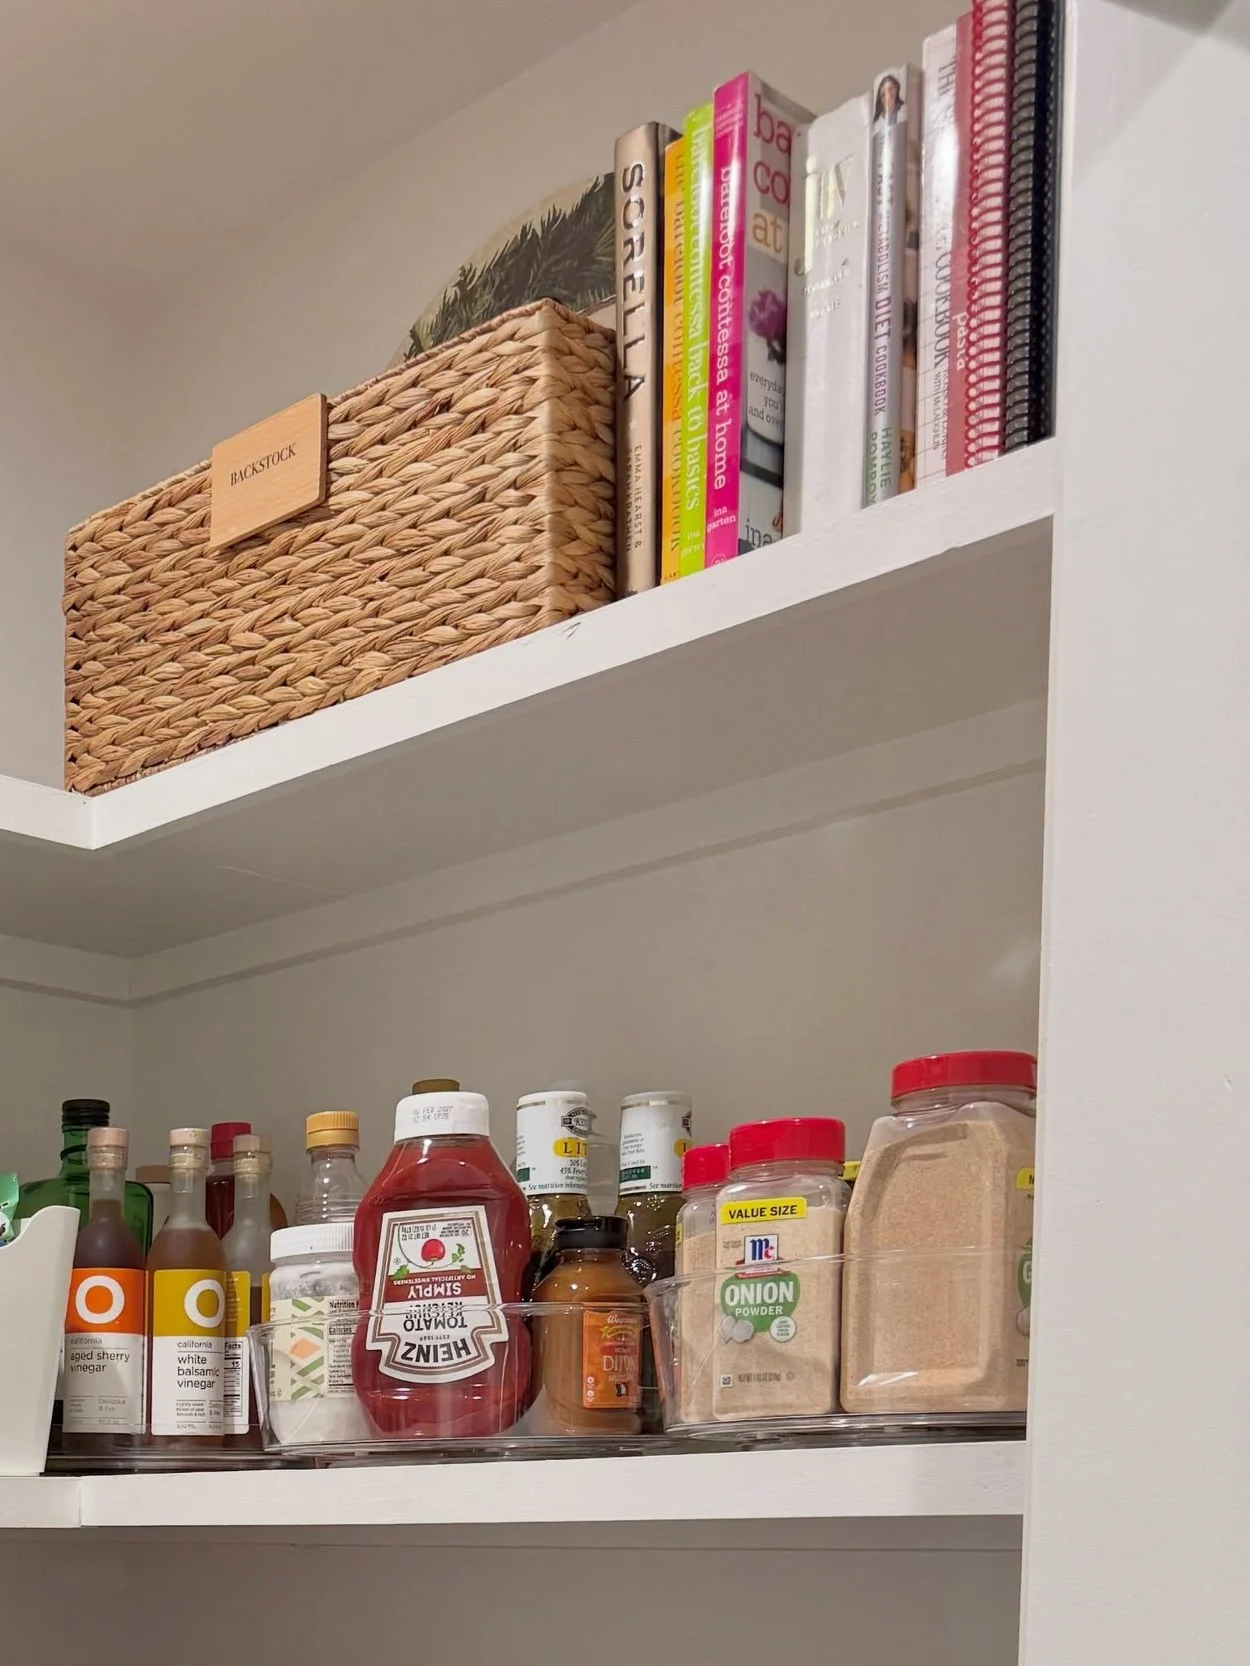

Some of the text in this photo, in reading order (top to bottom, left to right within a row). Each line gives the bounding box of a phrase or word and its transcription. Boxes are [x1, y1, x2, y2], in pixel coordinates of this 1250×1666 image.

[752, 212, 784, 253] at
[622, 163, 646, 400] SORELLA
[716, 274, 734, 384] contessa
[874, 296, 892, 340] DIET
[687, 343, 710, 397] back
[873, 345, 890, 416] COOKBOOK
[716, 389, 733, 416] at
[687, 406, 705, 431] to
[230, 443, 297, 487] BACKSTOCK
[713, 418, 732, 490] home
[879, 426, 893, 489] HAYLIE
[686, 434, 707, 511] basics
[706, 513, 737, 533] garten
[728, 1204, 798, 1219] VALUE SIZE
[393, 1276, 431, 1286] SWEETENERS
[407, 1281, 462, 1298] SIMPLY
[431, 1274, 466, 1283] ARTIFICIAL
[724, 1281, 794, 1307] ONION
[735, 1305, 783, 1317] POWDER
[403, 1316, 468, 1332] TOMATO
[70, 1336, 103, 1345] california
[177, 1340, 213, 1349] california
[400, 1338, 472, 1363] HEINZ
[70, 1350, 131, 1363] aged sherry
[177, 1355, 207, 1365] white
[70, 1363, 107, 1374] vinegar
[177, 1366, 220, 1377] balsamic
[177, 1379, 216, 1390] vinegar
